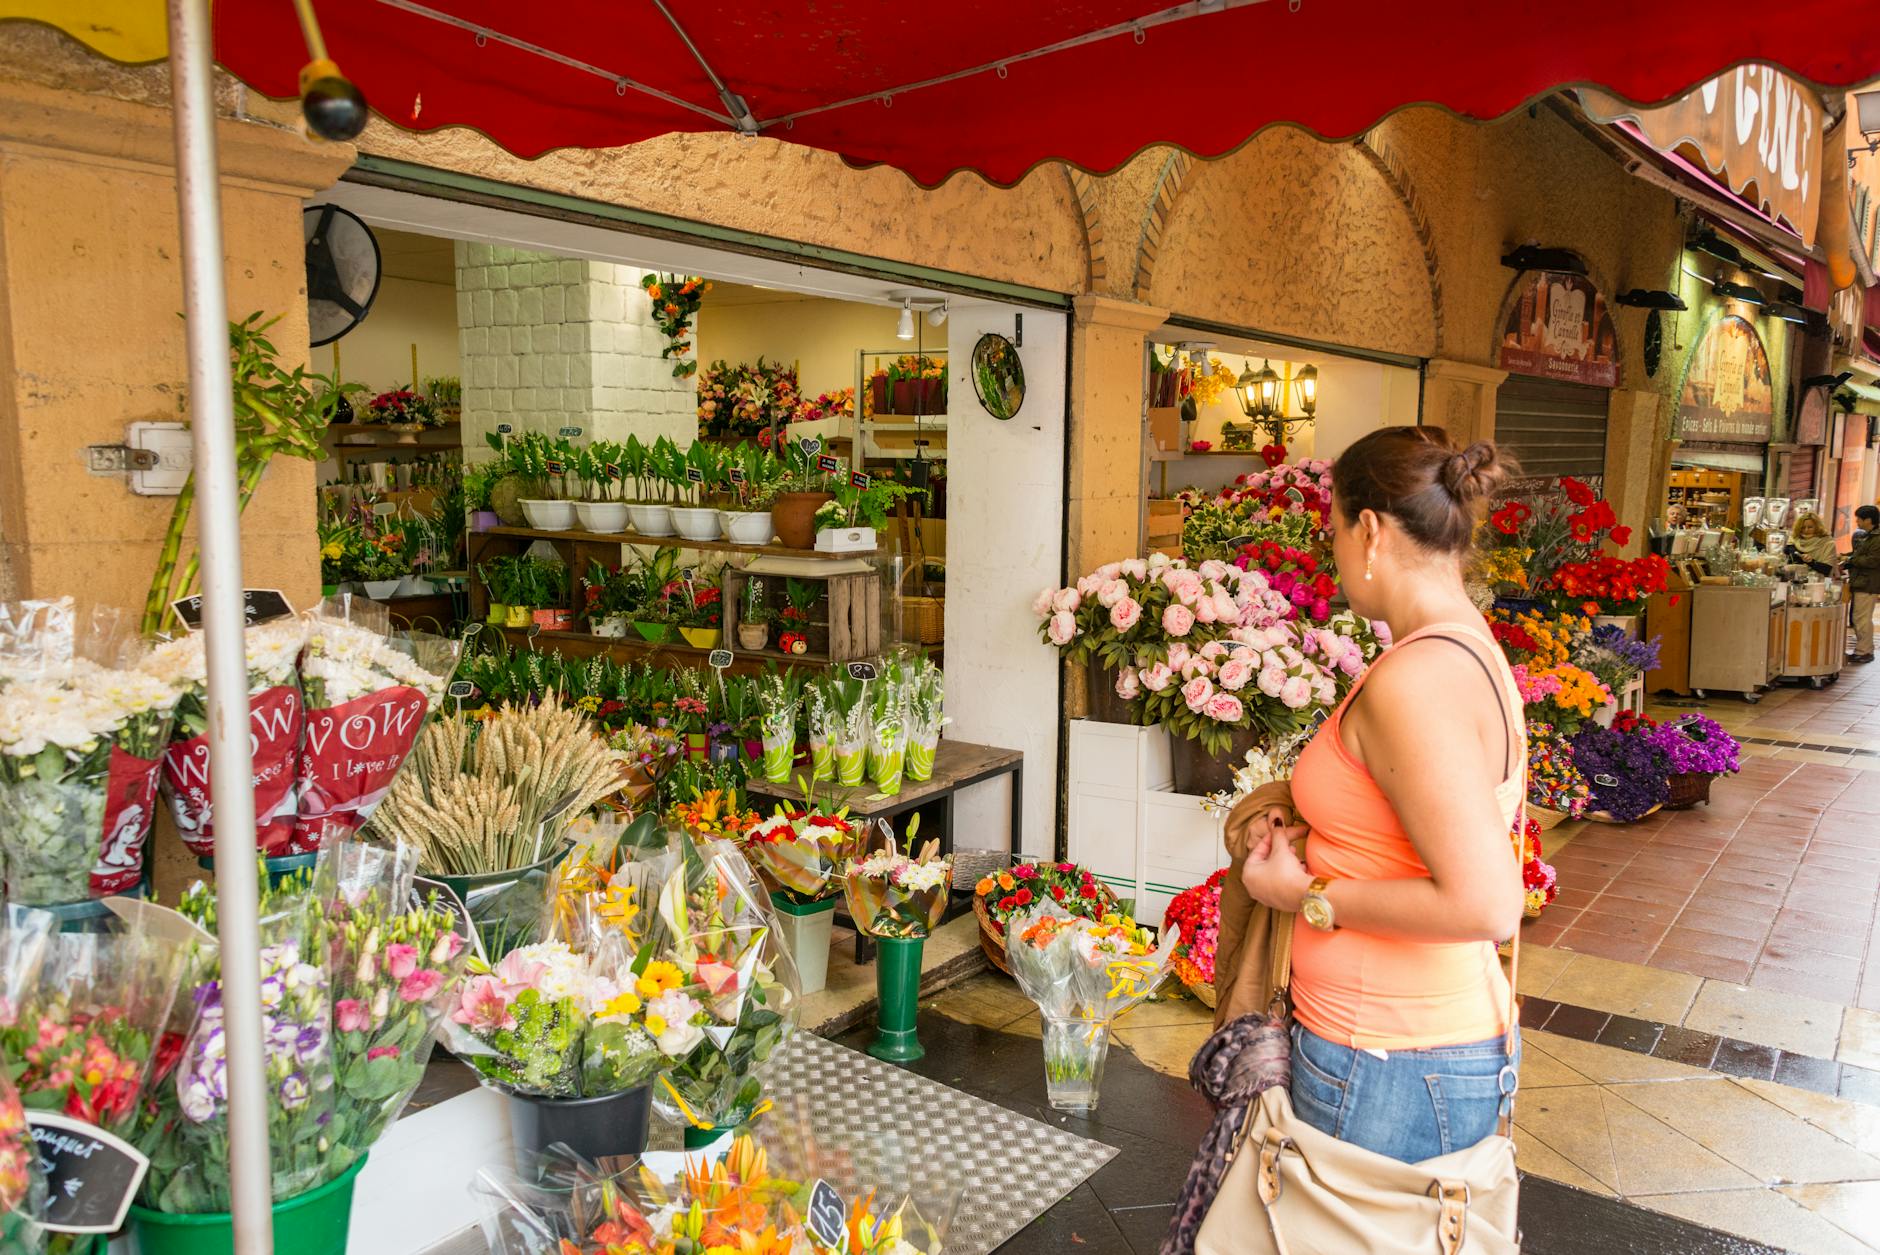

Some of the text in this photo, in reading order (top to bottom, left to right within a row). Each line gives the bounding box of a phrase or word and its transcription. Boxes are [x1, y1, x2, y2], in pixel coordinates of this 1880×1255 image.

[303, 699, 421, 757] WOW
[386, 754, 400, 770] it
[30, 1127, 105, 1160] ouquet
